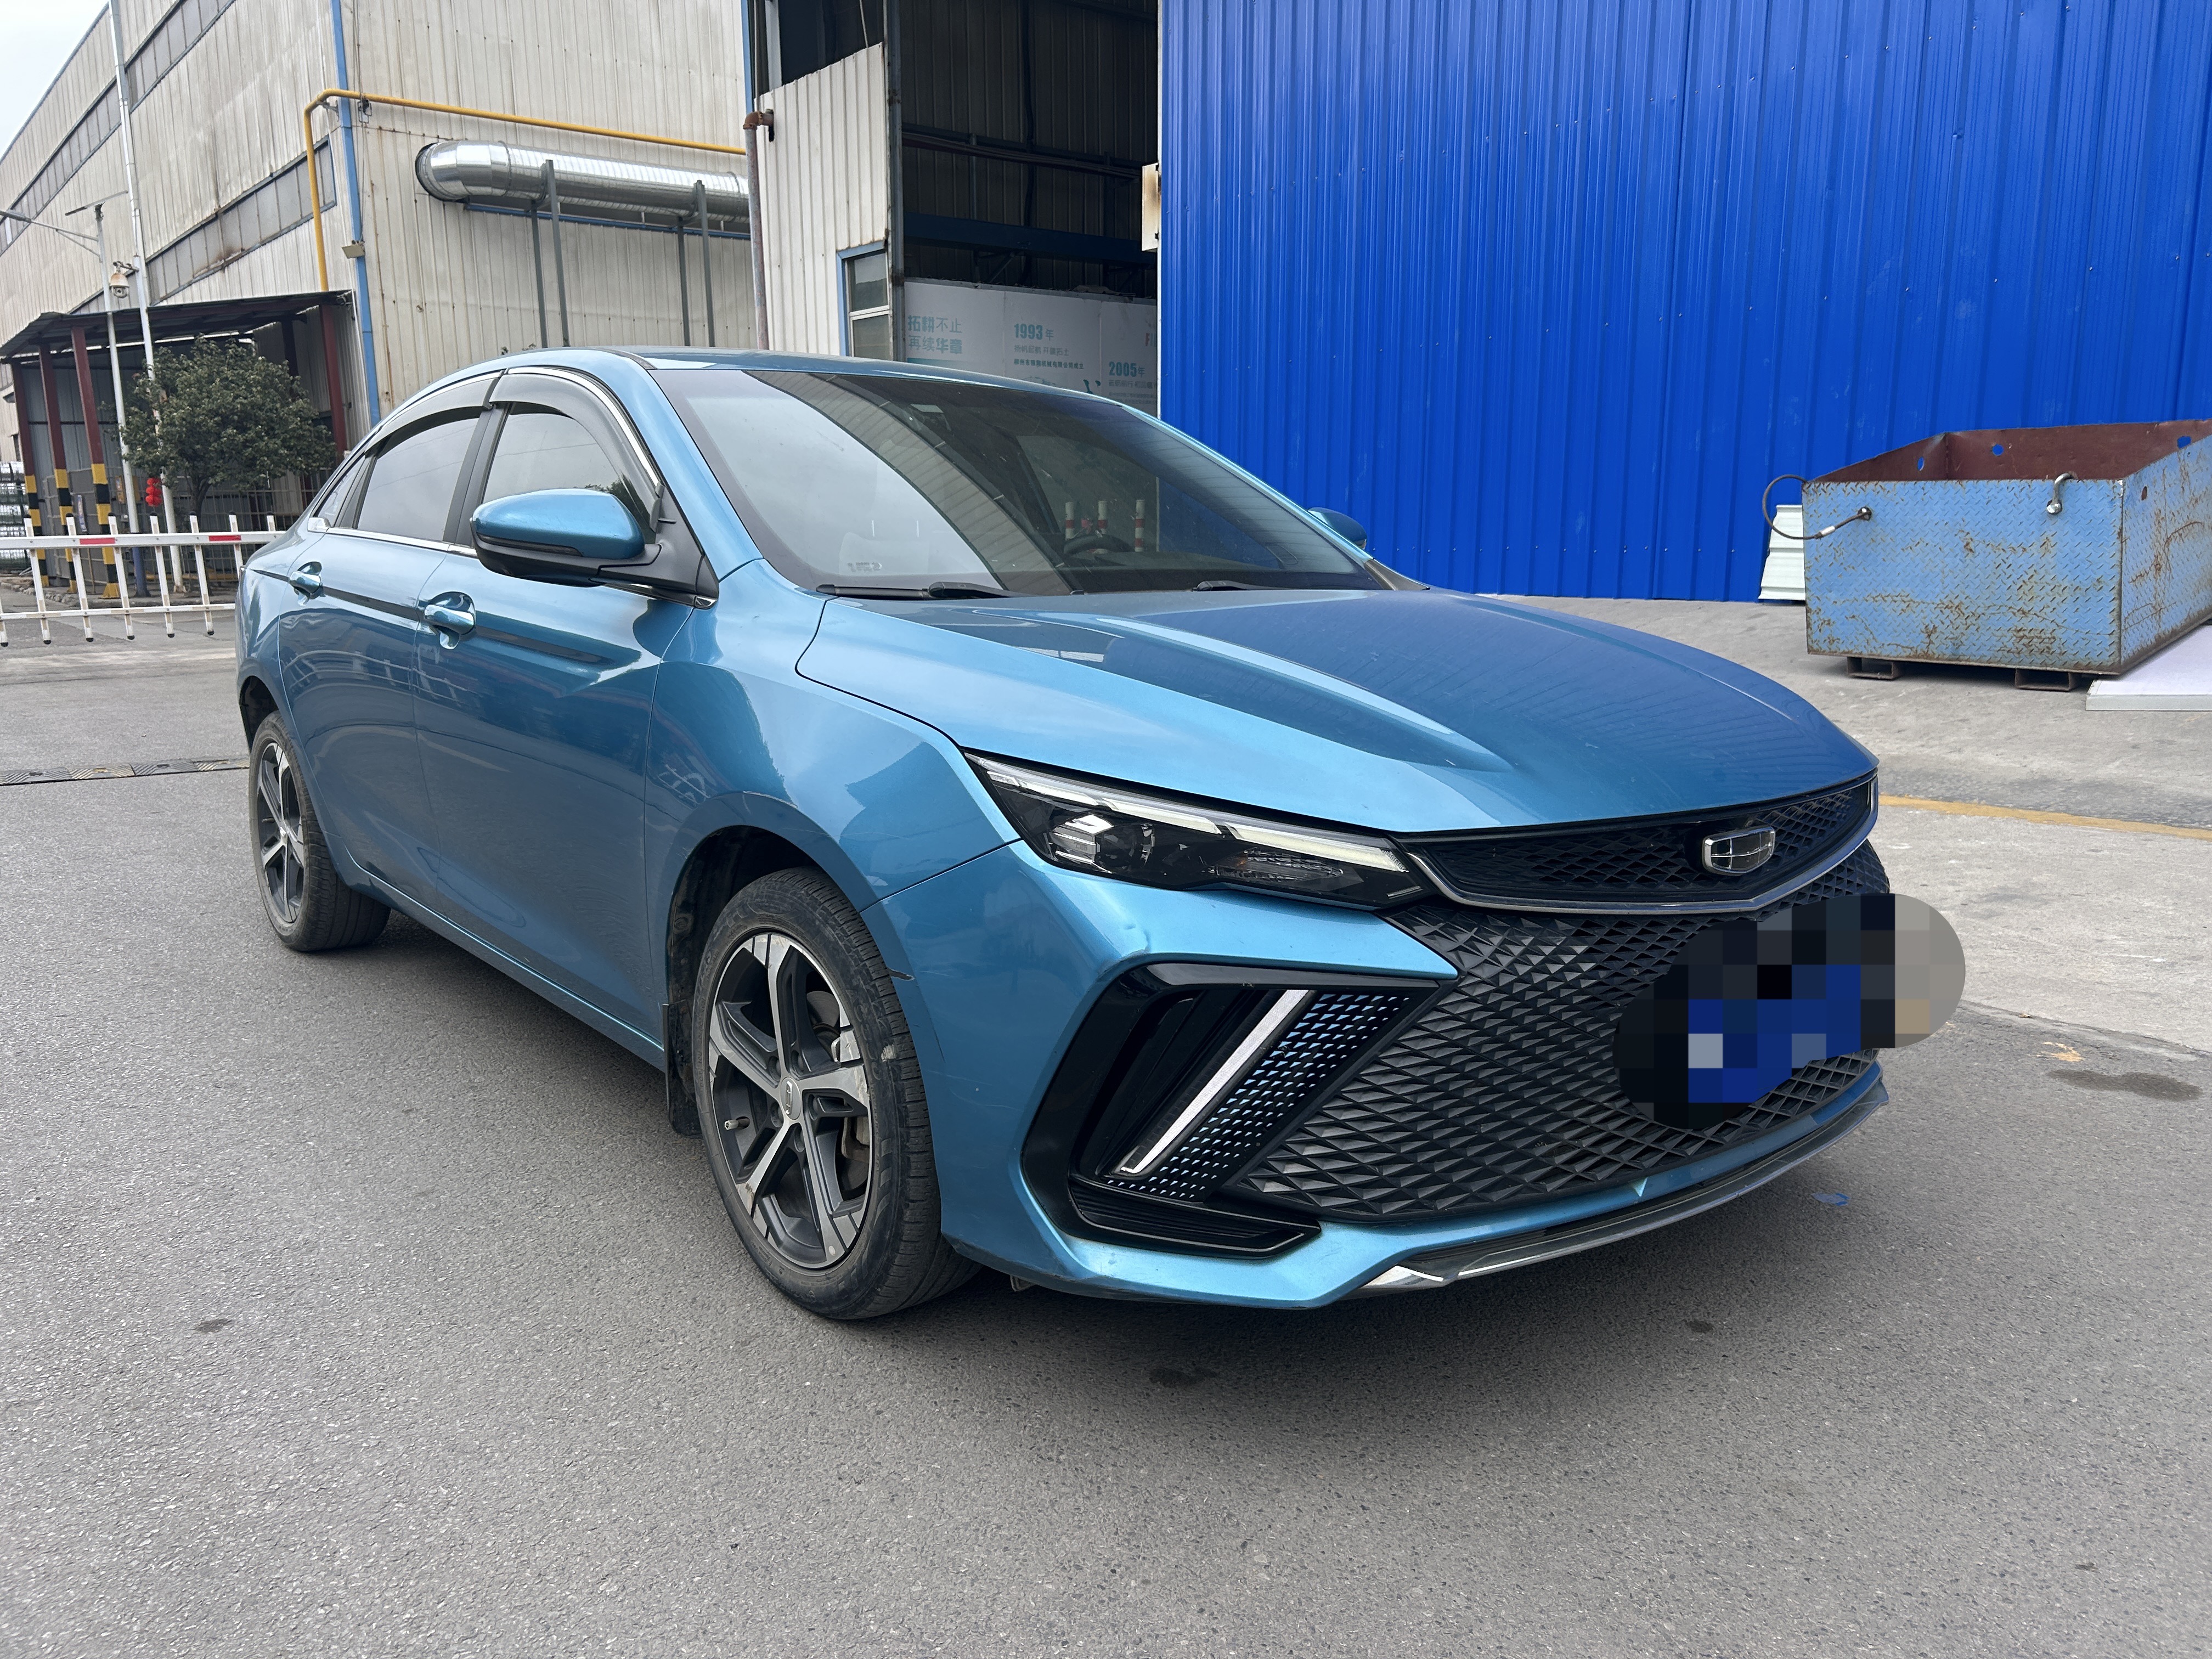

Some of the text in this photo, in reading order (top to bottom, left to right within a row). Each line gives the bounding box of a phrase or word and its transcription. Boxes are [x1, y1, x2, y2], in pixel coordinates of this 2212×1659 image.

[908, 315, 962, 332] 拓耕不止
[1014, 323, 1054, 341] 1993年
[909, 335, 962, 354] 再续华章
[1109, 362, 1145, 377] 2005年
